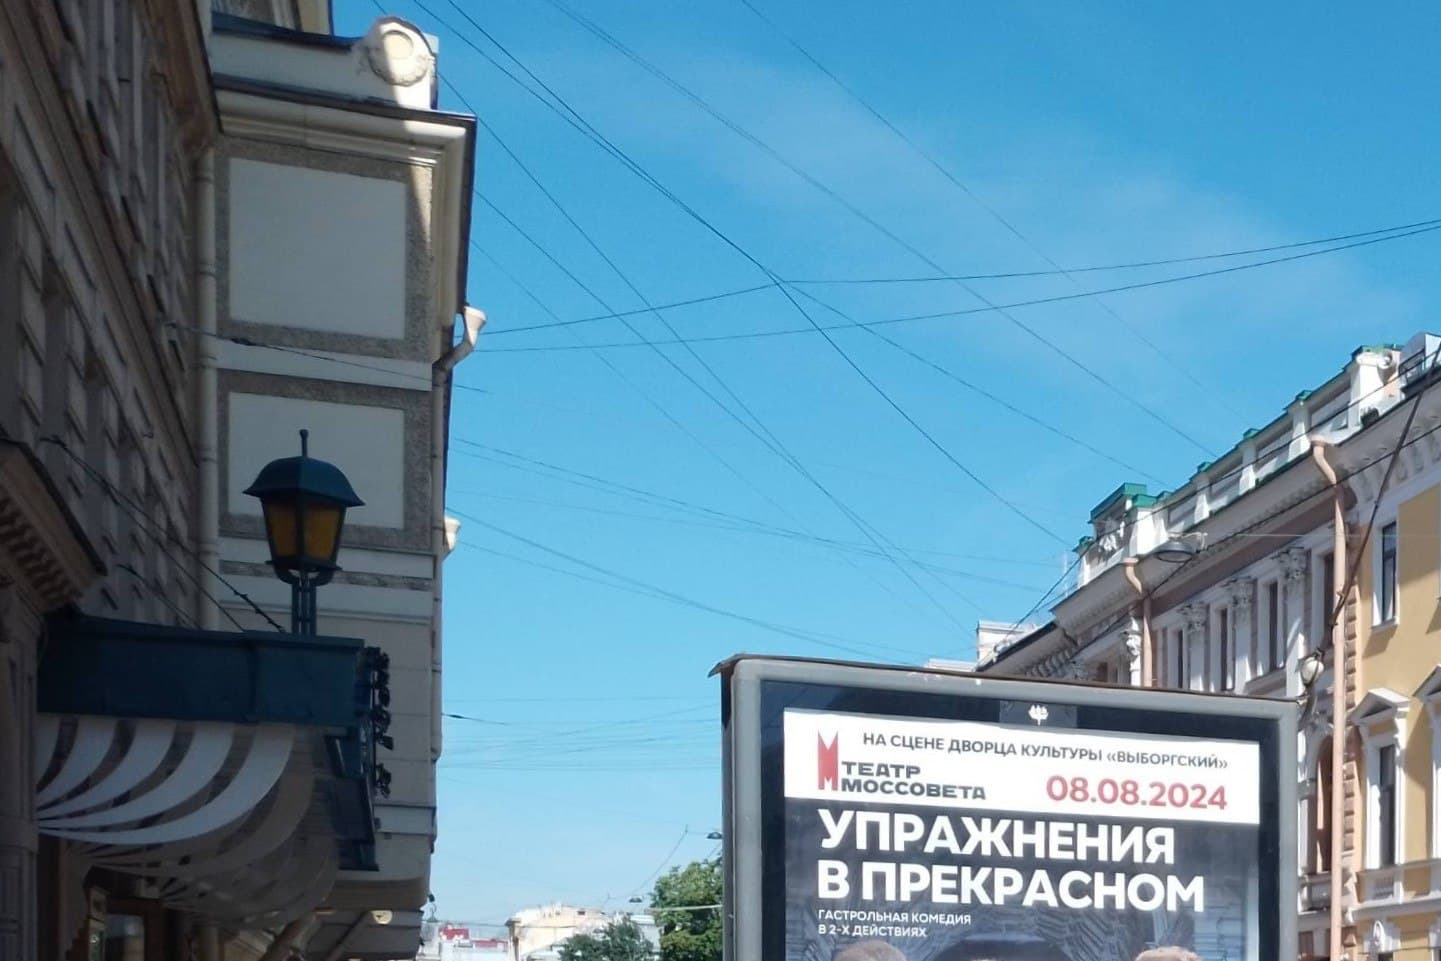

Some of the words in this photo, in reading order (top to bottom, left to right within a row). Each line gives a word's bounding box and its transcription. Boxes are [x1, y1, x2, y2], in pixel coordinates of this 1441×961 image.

[863, 732, 886, 746] НА
[891, 734, 944, 750] СЦЕНЕ
[948, 739, 1017, 757] ДВОРЦА
[1021, 744, 1102, 761] КУЛЬТУРЫ
[1106, 750, 1228, 769] «ВЫБОРГСКИЙ»
[842, 761, 920, 779] ТЕАТР
[842, 779, 986, 801] МОССОВЕТА
[1046, 775, 1228, 810] 08.08.2024
[817, 808, 1175, 865] УПРАЖНЕНИЯ
[818, 859, 850, 899] В
[862, 862, 1205, 913] ПРЕКРАСНОМ
[818, 909, 908, 924] ГАСТРОЛЬНАЯ
[911, 912, 972, 926] КОМЕДИЯ
[818, 925, 827, 935] В
[830, 925, 851, 936] 2-Х
[853, 923, 927, 938] ДЕЙСТВИЯХ
